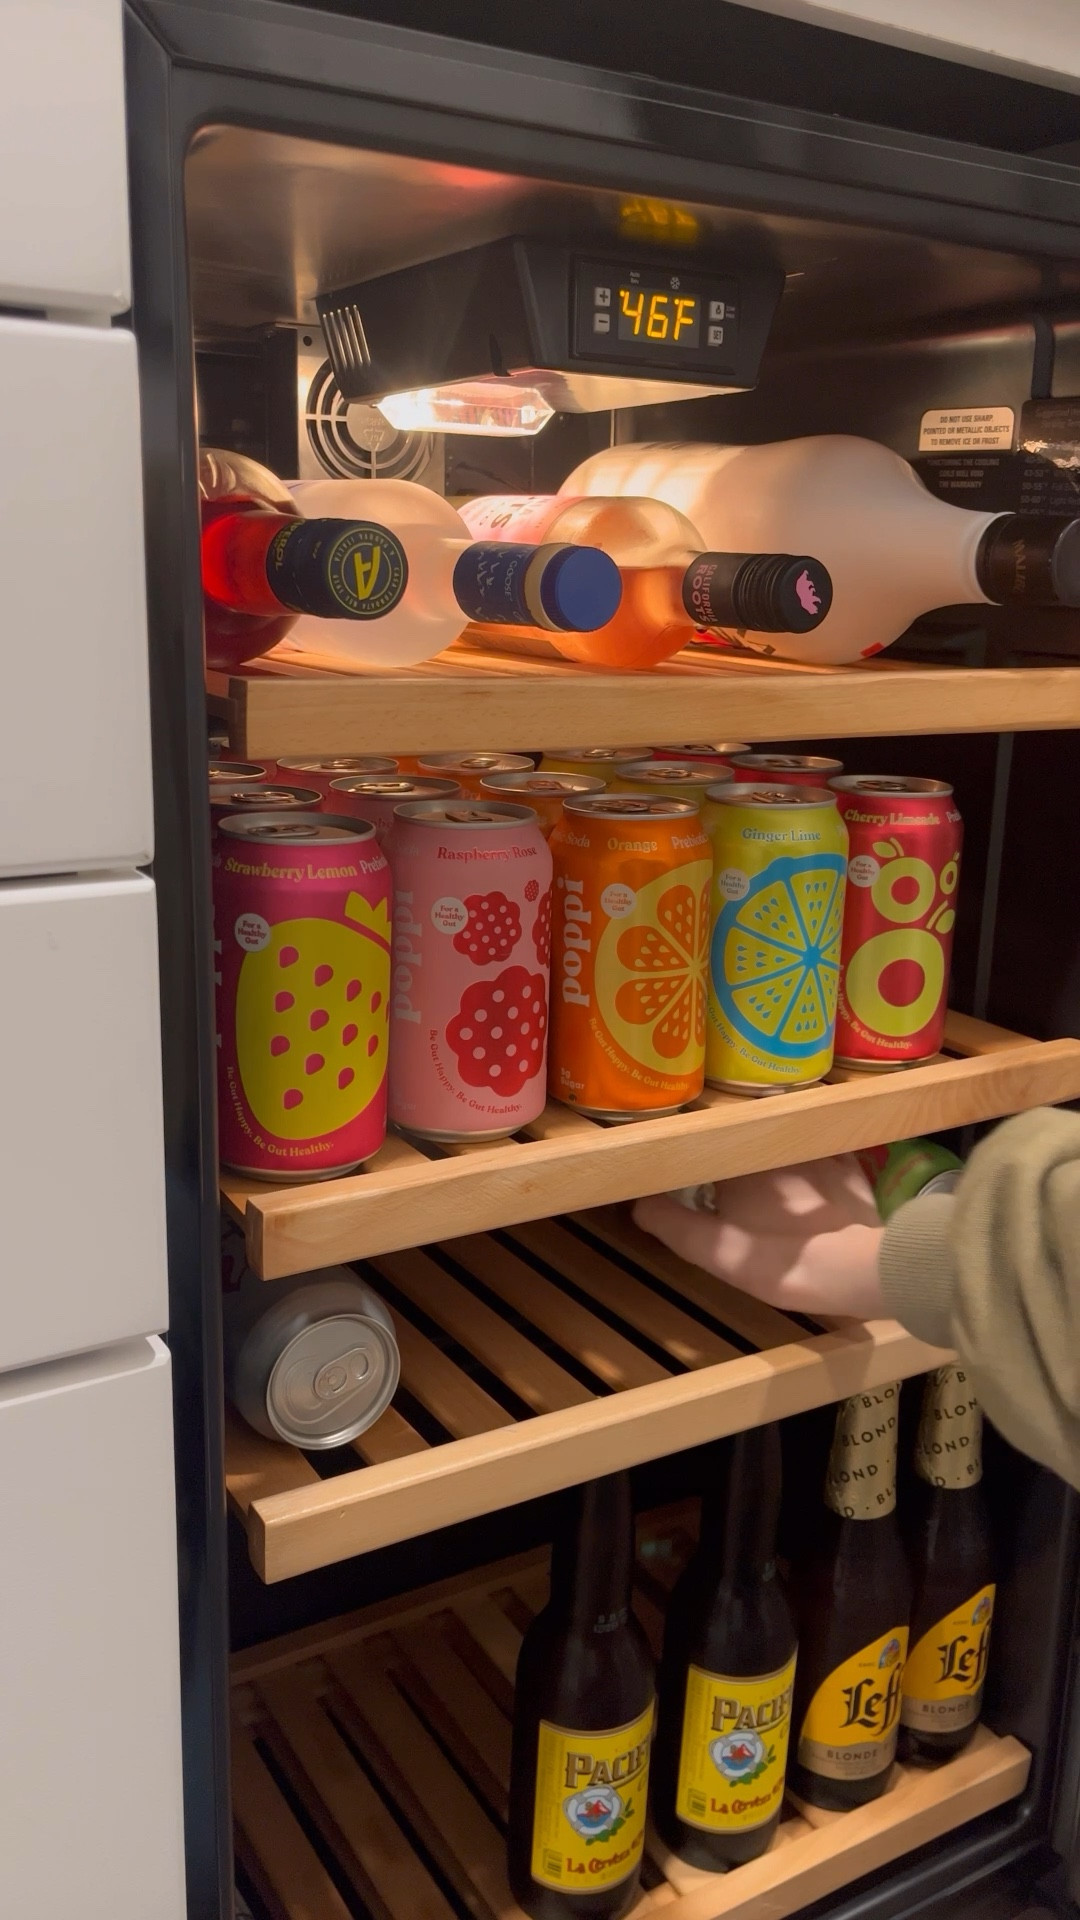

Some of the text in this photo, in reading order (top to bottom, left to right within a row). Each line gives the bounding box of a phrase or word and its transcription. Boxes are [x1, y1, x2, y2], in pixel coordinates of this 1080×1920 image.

[619, 290, 696, 341] 46F
[961, 415, 972, 423] USE
[923, 425, 1010, 435] POINTED OR METALLIC OBJECTS
[931, 438, 938, 446] TO
[939, 438, 961, 446] REMOVE
[982, 437, 1000, 445] FROST
[354, 546, 381, 600] A
[504, 560, 518, 596] GOOSE
[692, 564, 711, 623] ROOTS
[701, 564, 718, 623] CALIFORNIA
[844, 809, 888, 827] Cherry
[566, 832, 590, 848] Soda
[742, 827, 788, 842] Ginger
[790, 829, 821, 841] Lime
[607, 837, 658, 853] Orange
[436, 846, 510, 863] Raspberry
[511, 846, 538, 858] Rose
[224, 857, 305, 883] Strawberry
[307, 863, 358, 881] Lemon
[242, 920, 255, 929] For
[434, 912, 465, 922] Healthy
[442, 919, 457, 928] Gut
[237, 927, 268, 940] Healthy
[244, 936, 259, 946] Gut
[557, 874, 592, 1007] poppi
[394, 890, 422, 1025] poppi
[709, 1006, 719, 1022] Gut
[740, 1047, 751, 1058] Be
[751, 1055, 767, 1068] Gut
[589, 1017, 597, 1031] Be
[594, 1029, 608, 1048] Gut
[604, 1045, 630, 1074] Happy.
[631, 1069, 643, 1081] Be
[643, 1077, 660, 1088] Gut
[429, 1029, 522, 1114] Be Gut Happy. Be Gut Healthy.
[560, 1076, 585, 1090] Sugar
[229, 1081, 239, 1101] Gut
[234, 1101, 253, 1138] Happy.
[253, 1135, 266, 1149] Be
[267, 1145, 288, 1157] Gut
[289, 1141, 335, 1157] Healthy.
[862, 1382, 900, 1408] BLO
[923, 1436, 970, 1455] LOND
[832, 1464, 879, 1485] LOND
[921, 1701, 970, 1714] BLONDE
[826, 1749, 877, 1761] BLONDE
[710, 1798, 729, 1814] La
[566, 1857, 585, 1874] La
